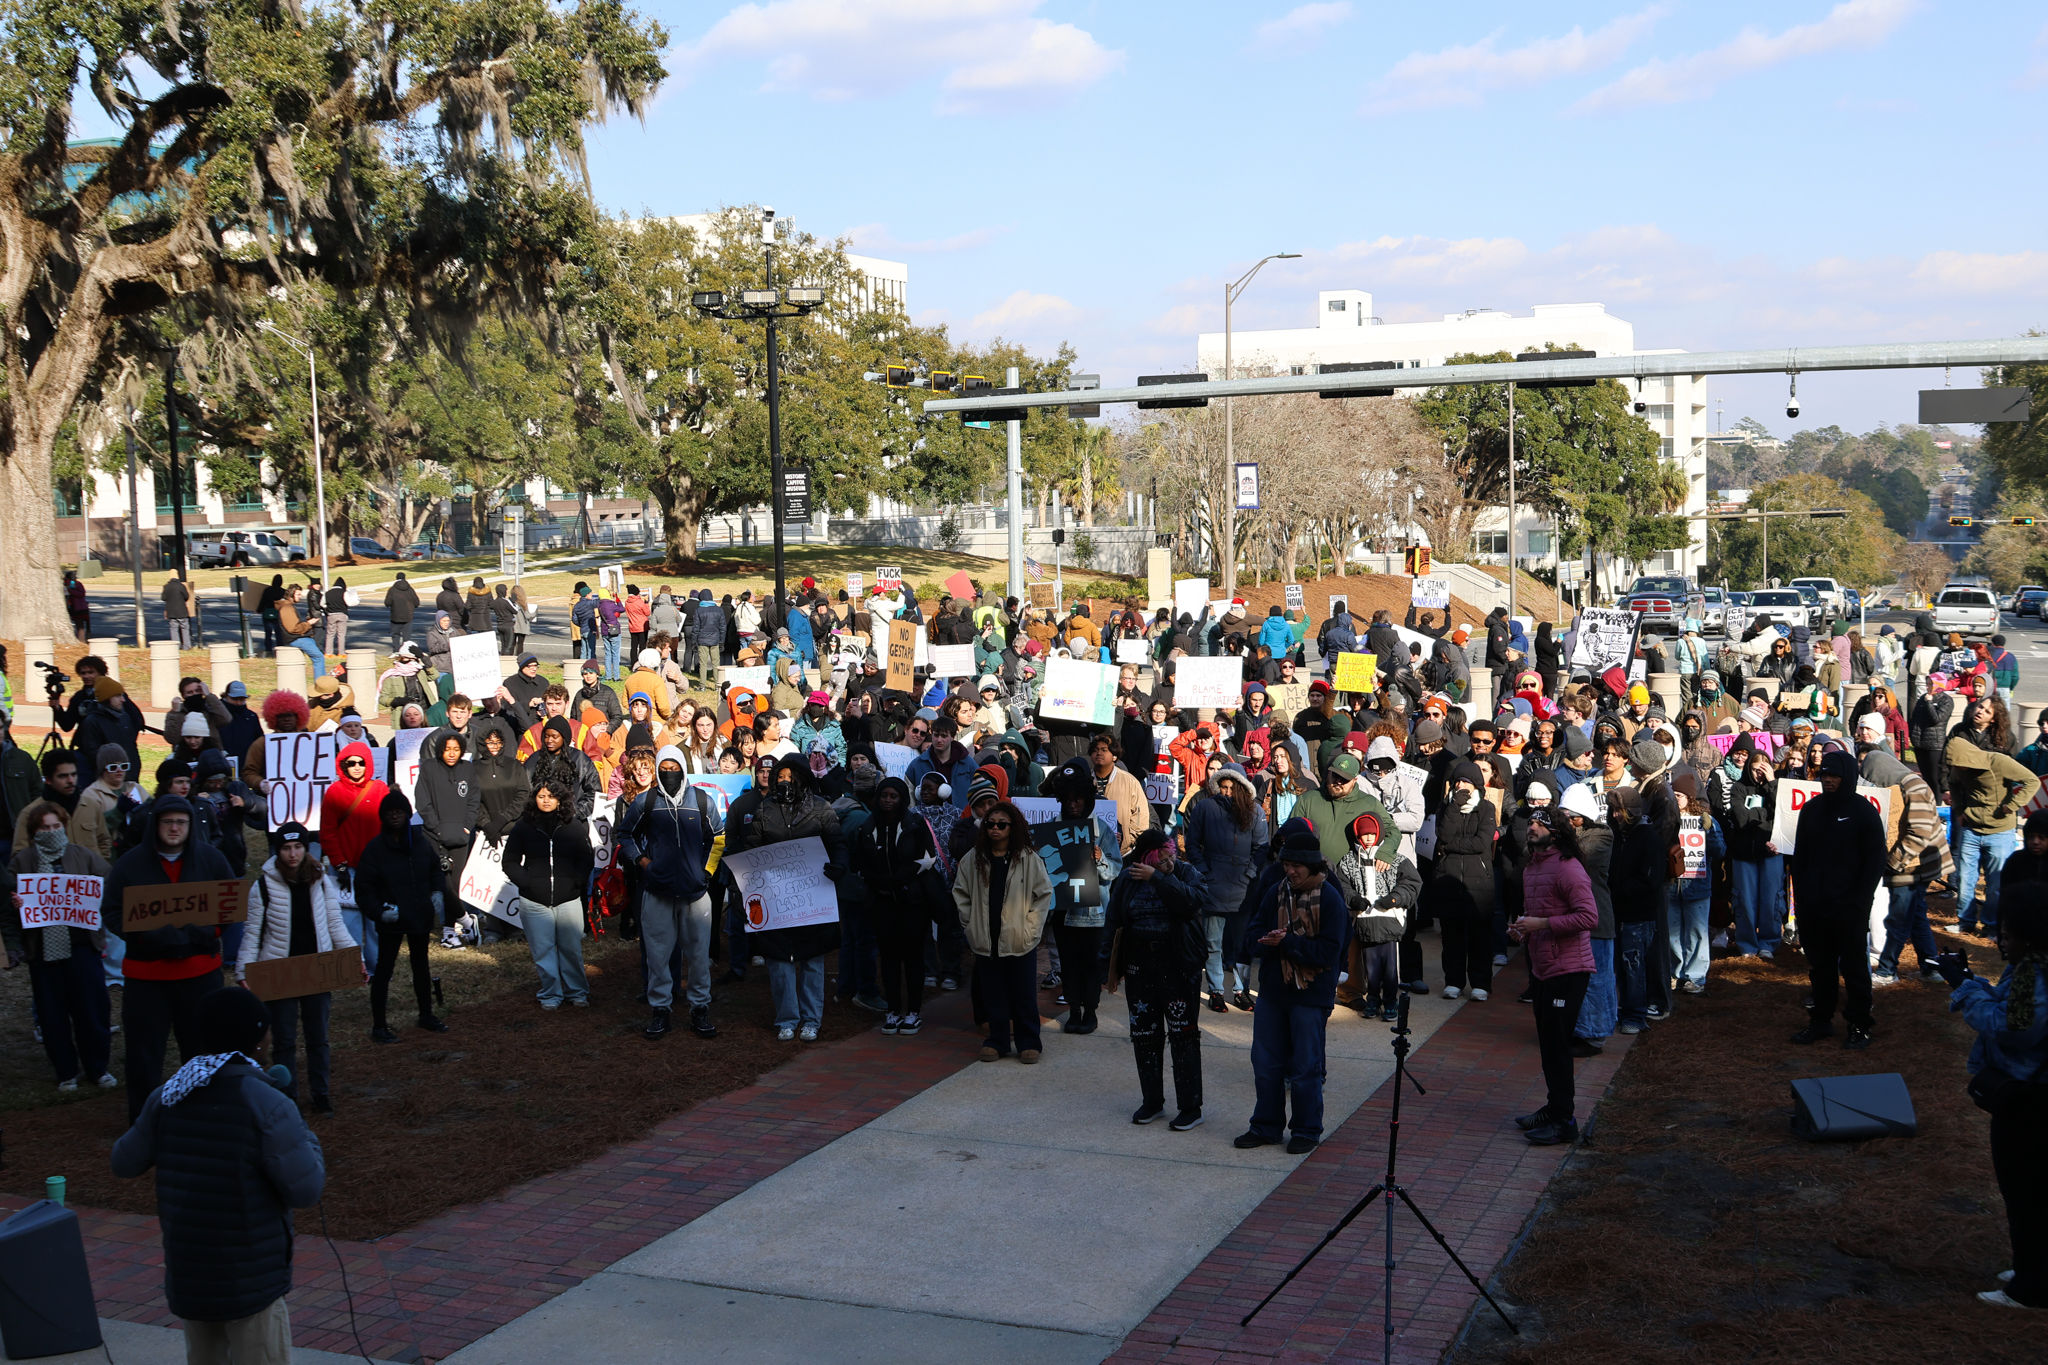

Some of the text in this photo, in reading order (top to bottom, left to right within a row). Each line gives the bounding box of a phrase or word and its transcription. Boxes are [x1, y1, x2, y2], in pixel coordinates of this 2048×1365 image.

[877, 568, 901, 579] FUCK
[877, 579, 902, 590] TRUMP
[1416, 580, 1447, 590] WE STAND
[1423, 589, 1439, 597] WITH
[1287, 598, 1302, 607] NOW
[900, 627, 909, 641] NO
[889, 643, 914, 660] GESTAPO
[1177, 657, 1237, 666] THEY BLAME
[1367, 657, 1376, 666] IS
[755, 668, 769, 678] ICE
[892, 661, 910, 676] IN TLH
[1179, 675, 1188, 683] SO
[1196, 675, 1212, 684] YOU
[1192, 684, 1223, 694] BLAME
[1177, 695, 1237, 706] BILLIONAIRE
[1283, 697, 1302, 710] ICE
[269, 732, 333, 781] ICE
[1147, 773, 1176, 784] TCHING
[271, 780, 332, 826] OUT
[745, 843, 806, 867] NO ONE
[19, 876, 102, 898] ICE MELTS
[741, 870, 765, 892] IS
[762, 875, 820, 902] ON STOLEN
[38, 894, 83, 906] UNDER
[217, 881, 240, 924] ICE
[775, 894, 806, 914] LAND
[127, 893, 209, 922] ABOLISH
[24, 907, 98, 926] RESISTANCE
[317, 948, 361, 989] ICE
